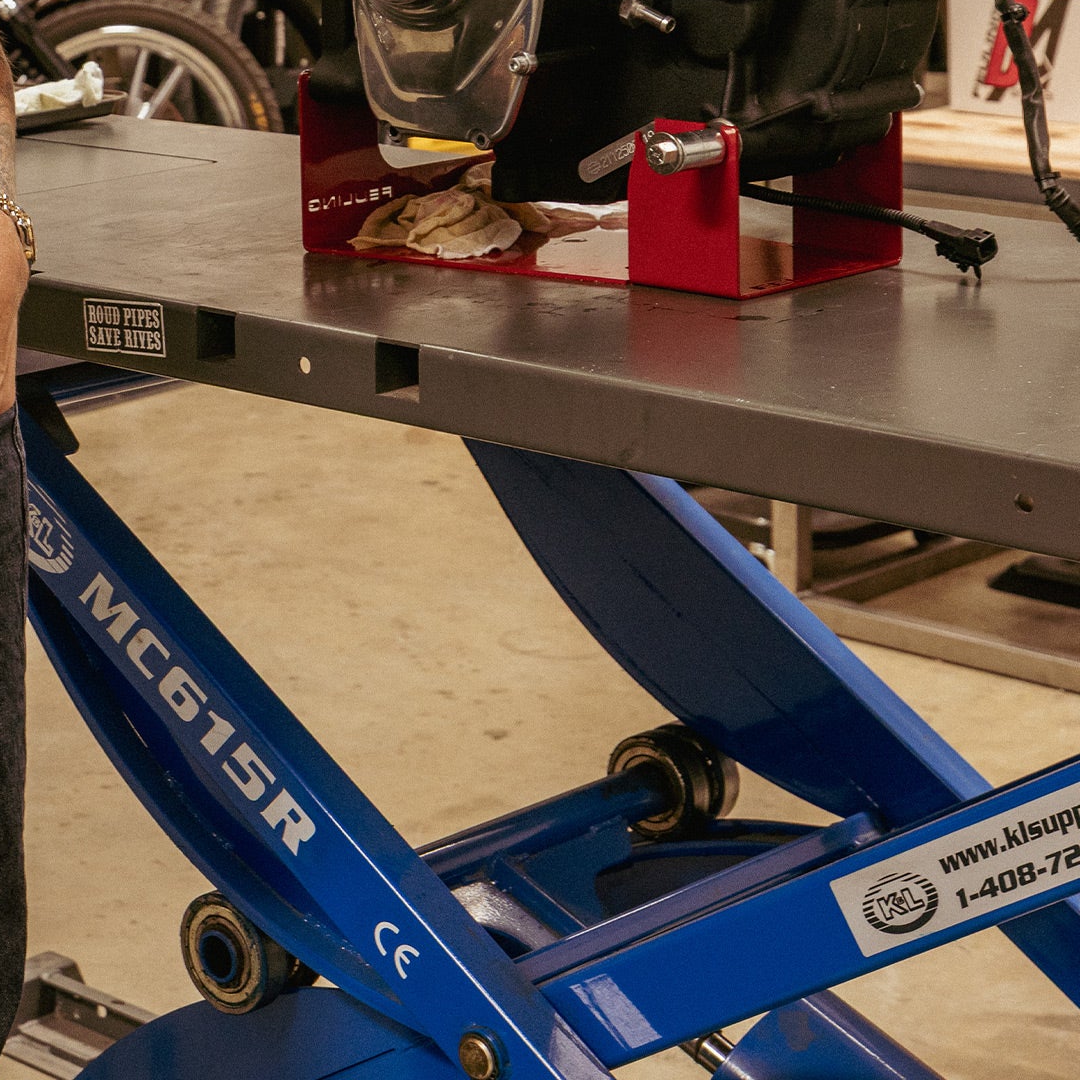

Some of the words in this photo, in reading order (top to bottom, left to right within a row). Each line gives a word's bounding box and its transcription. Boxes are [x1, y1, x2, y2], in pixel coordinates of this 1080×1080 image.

[89, 325, 122, 347] SAVE
[122, 307, 160, 329] PIPES
[78, 572, 316, 857] MC615R
[956, 844, 1080, 909] 1-408-72
[374, 921, 420, 980] CE
